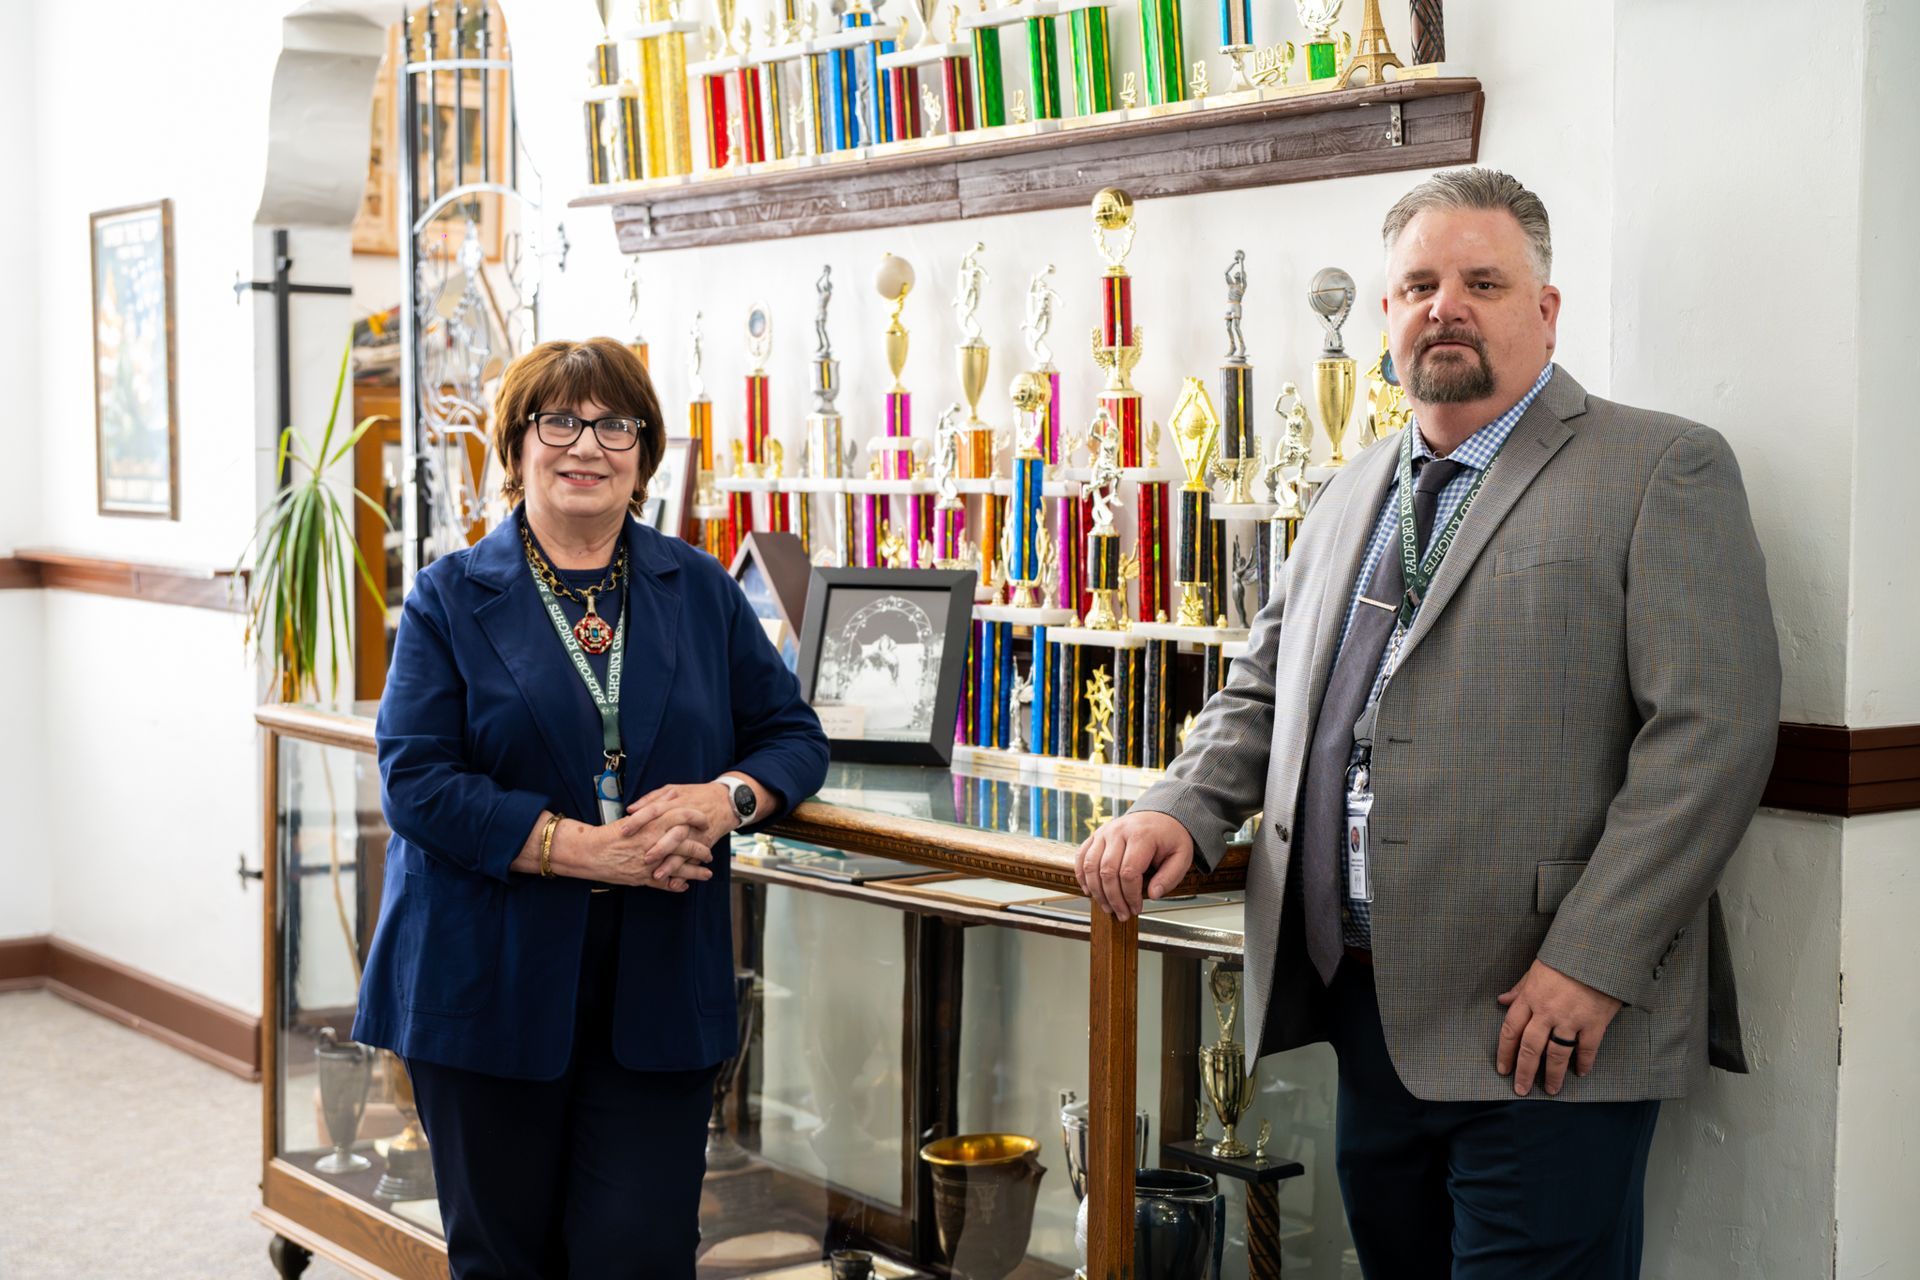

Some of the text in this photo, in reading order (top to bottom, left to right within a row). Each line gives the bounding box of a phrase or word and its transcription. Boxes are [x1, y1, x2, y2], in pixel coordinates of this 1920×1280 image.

[1400, 465, 1417, 575] RADFORD KNIGHTS
[1423, 515, 1463, 576] KNIGHTS
[548, 603, 607, 705] RADFORD KNIGHTS
[608, 651, 622, 703] KNIGHTS
